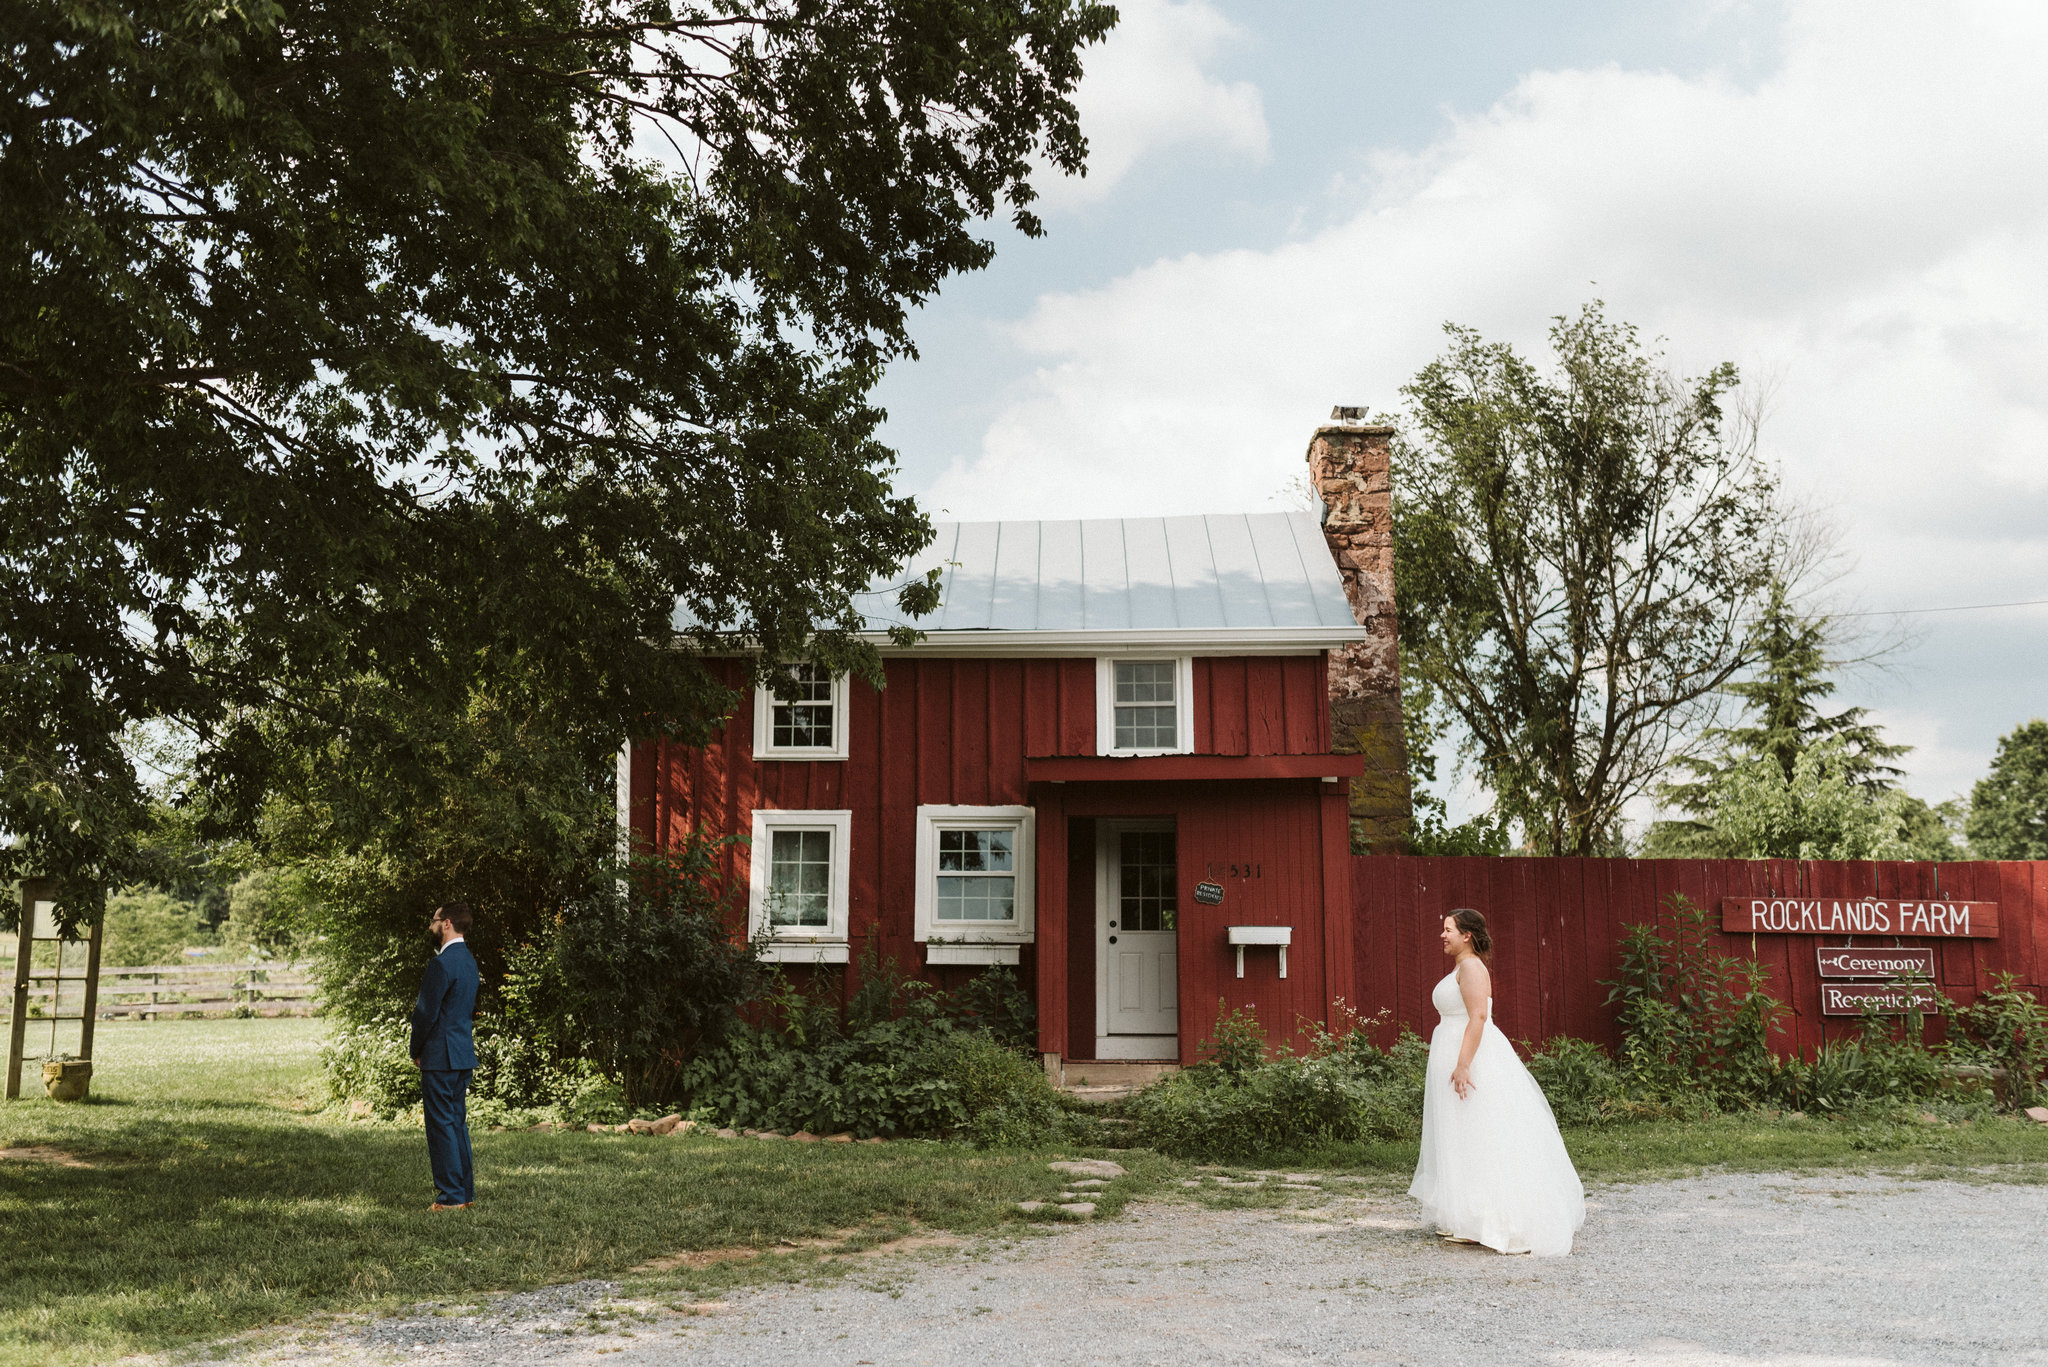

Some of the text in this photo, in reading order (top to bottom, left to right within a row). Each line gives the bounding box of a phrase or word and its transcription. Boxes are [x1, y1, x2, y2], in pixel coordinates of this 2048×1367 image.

[1200, 884, 1221, 894] PRIVATE
[1751, 900, 1970, 935] ROCKLANDS FARM
[1838, 954, 1926, 974] Ceremony
